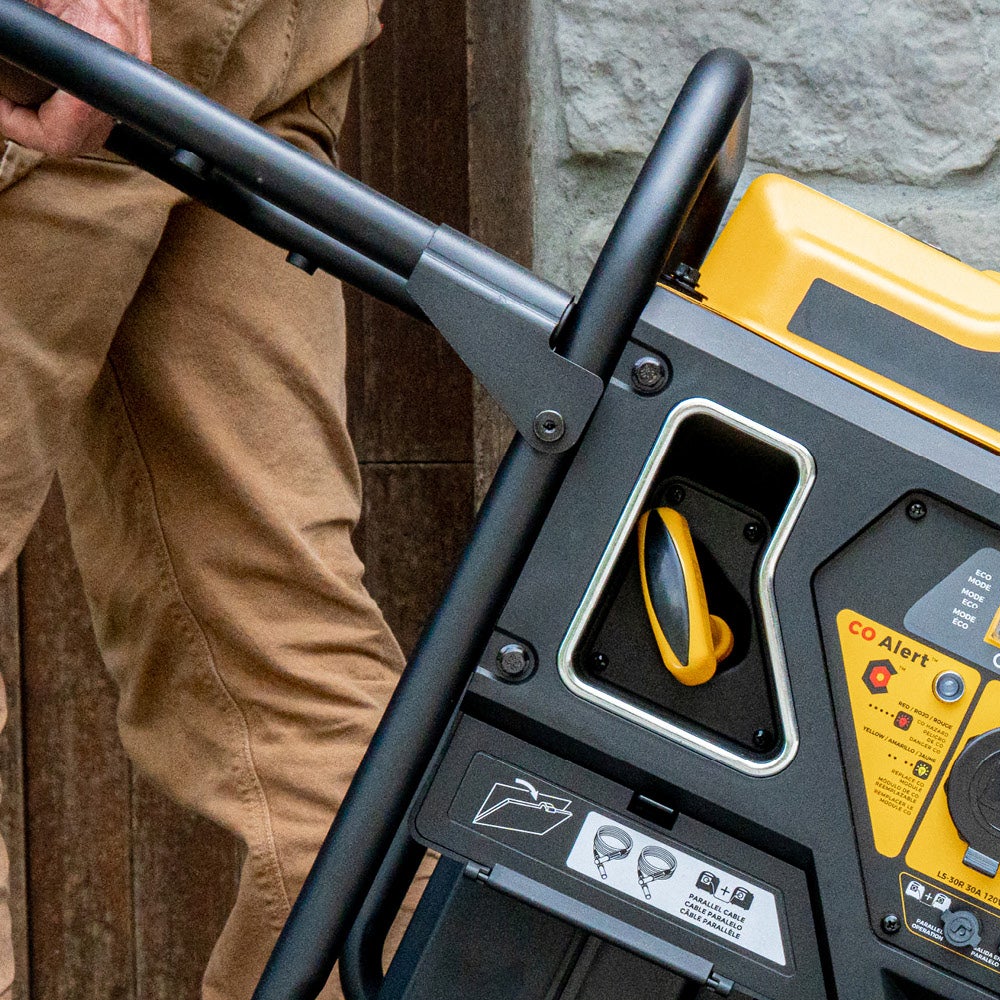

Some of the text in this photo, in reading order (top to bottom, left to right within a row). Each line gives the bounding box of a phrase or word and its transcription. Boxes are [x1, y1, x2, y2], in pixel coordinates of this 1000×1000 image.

[975, 569, 992, 581] ECO
[967, 576, 992, 592] MODE
[961, 587, 985, 603] MODE
[961, 598, 979, 609] ECO
[952, 607, 976, 623] MODE
[848, 620, 876, 641] CO
[878, 636, 930, 668] Alert
[937, 870, 965, 889] L5-30R
[966, 883, 982, 896] 30A
[679, 908, 701, 923] CÂBLE
[684, 901, 743, 931] CABLE PARALELO
[688, 894, 746, 924] PARALLEL CABLE
[911, 923, 944, 941] OPERATION
[916, 918, 944, 934] PARALLEL
[970, 951, 1000, 968] PARALELO
